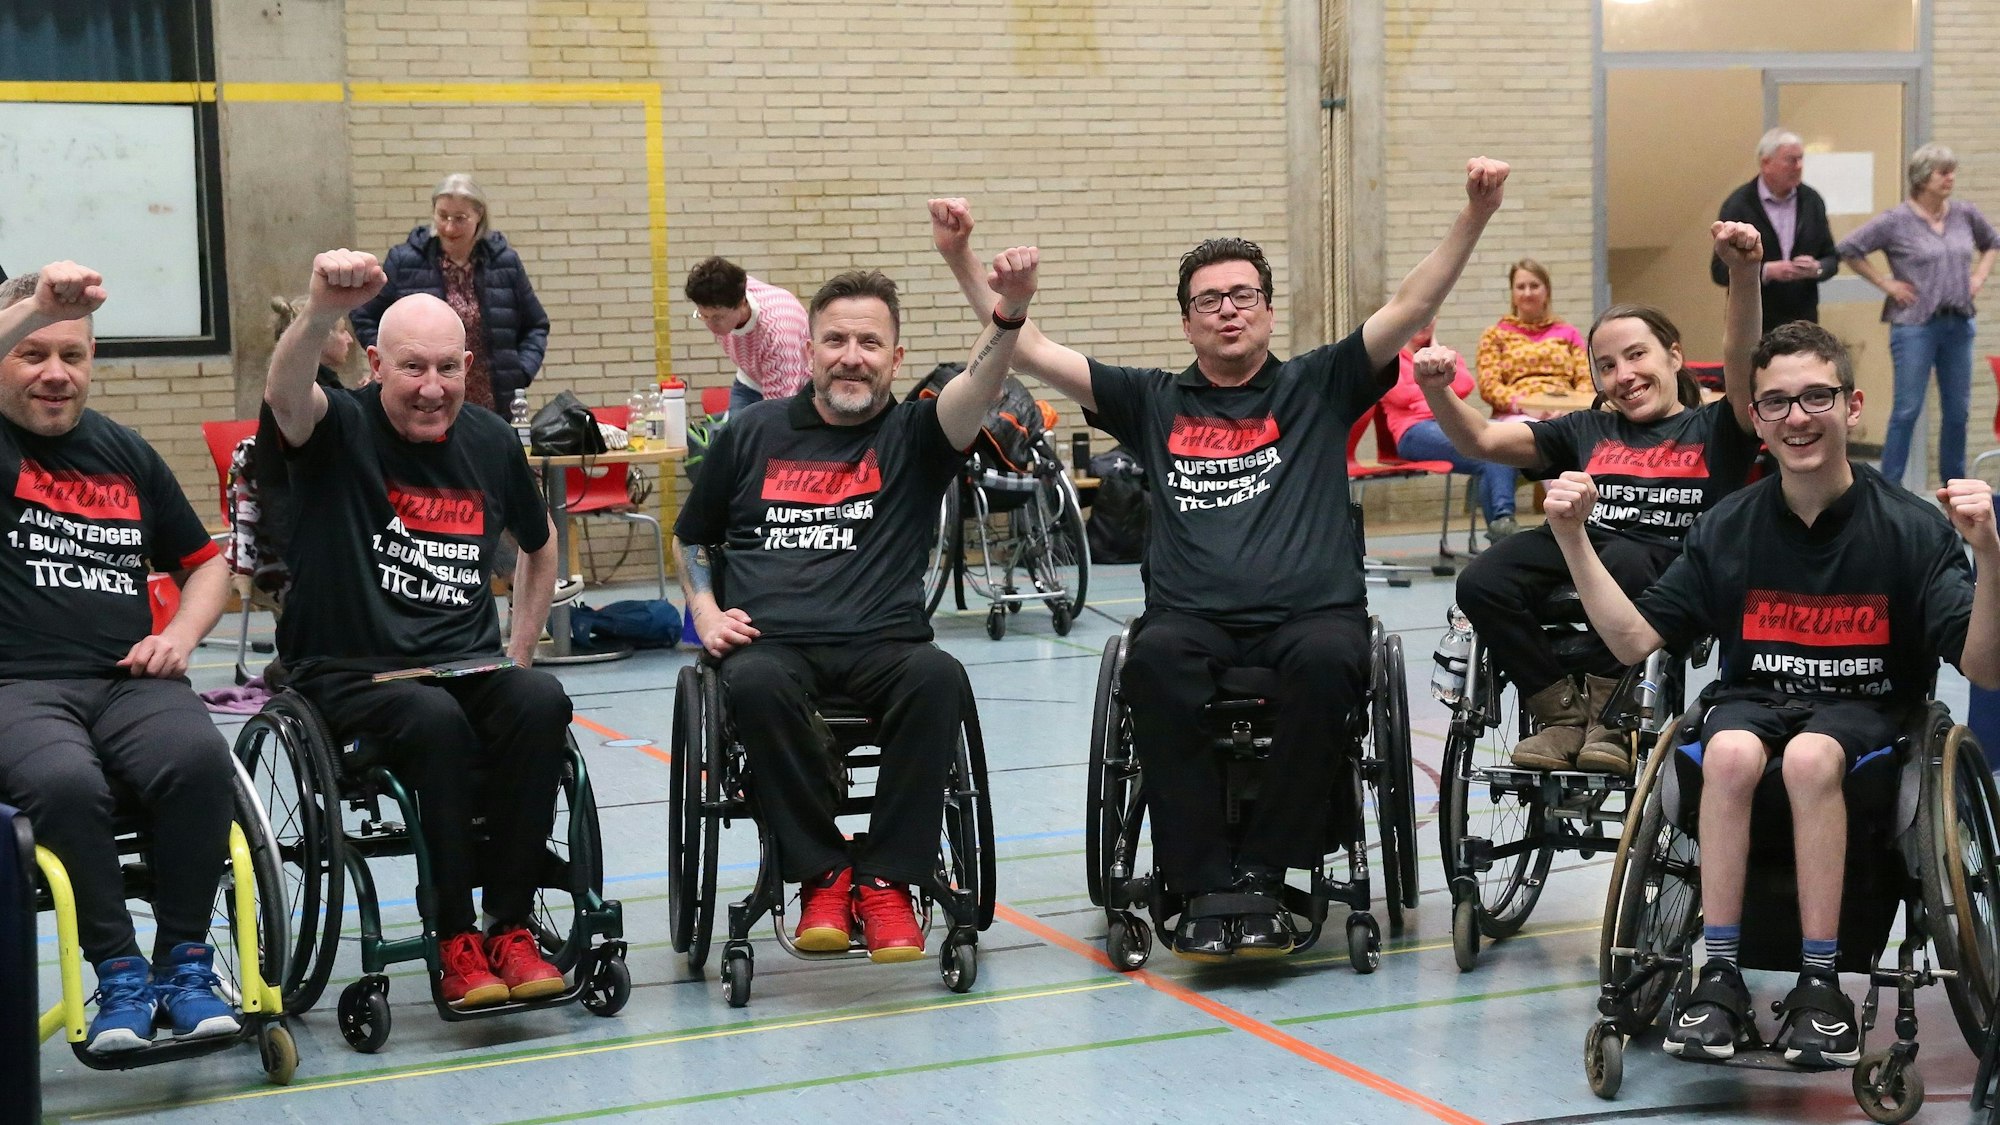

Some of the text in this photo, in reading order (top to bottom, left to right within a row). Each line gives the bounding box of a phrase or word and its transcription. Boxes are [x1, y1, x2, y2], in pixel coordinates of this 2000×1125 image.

[1180, 426, 1262, 452] MIZUN
[1175, 446, 1281, 475] AUFSTEIGER
[1167, 471, 1178, 488] 1.
[1216, 479, 1271, 508] WIEHL
[1599, 484, 1703, 504] UFSTEIGER
[765, 499, 873, 523] AUFSTEIGE
[1591, 502, 1703, 527] BUNDESLIG
[7, 530, 25, 548] 1.
[19, 508, 142, 546] AUFSTEIGER
[386, 515, 480, 561] AUTEIGER
[372, 534, 384, 552] 1.
[1759, 602, 1876, 634] MIZUNO
[1752, 653, 1884, 677] AUFSTEIGER
